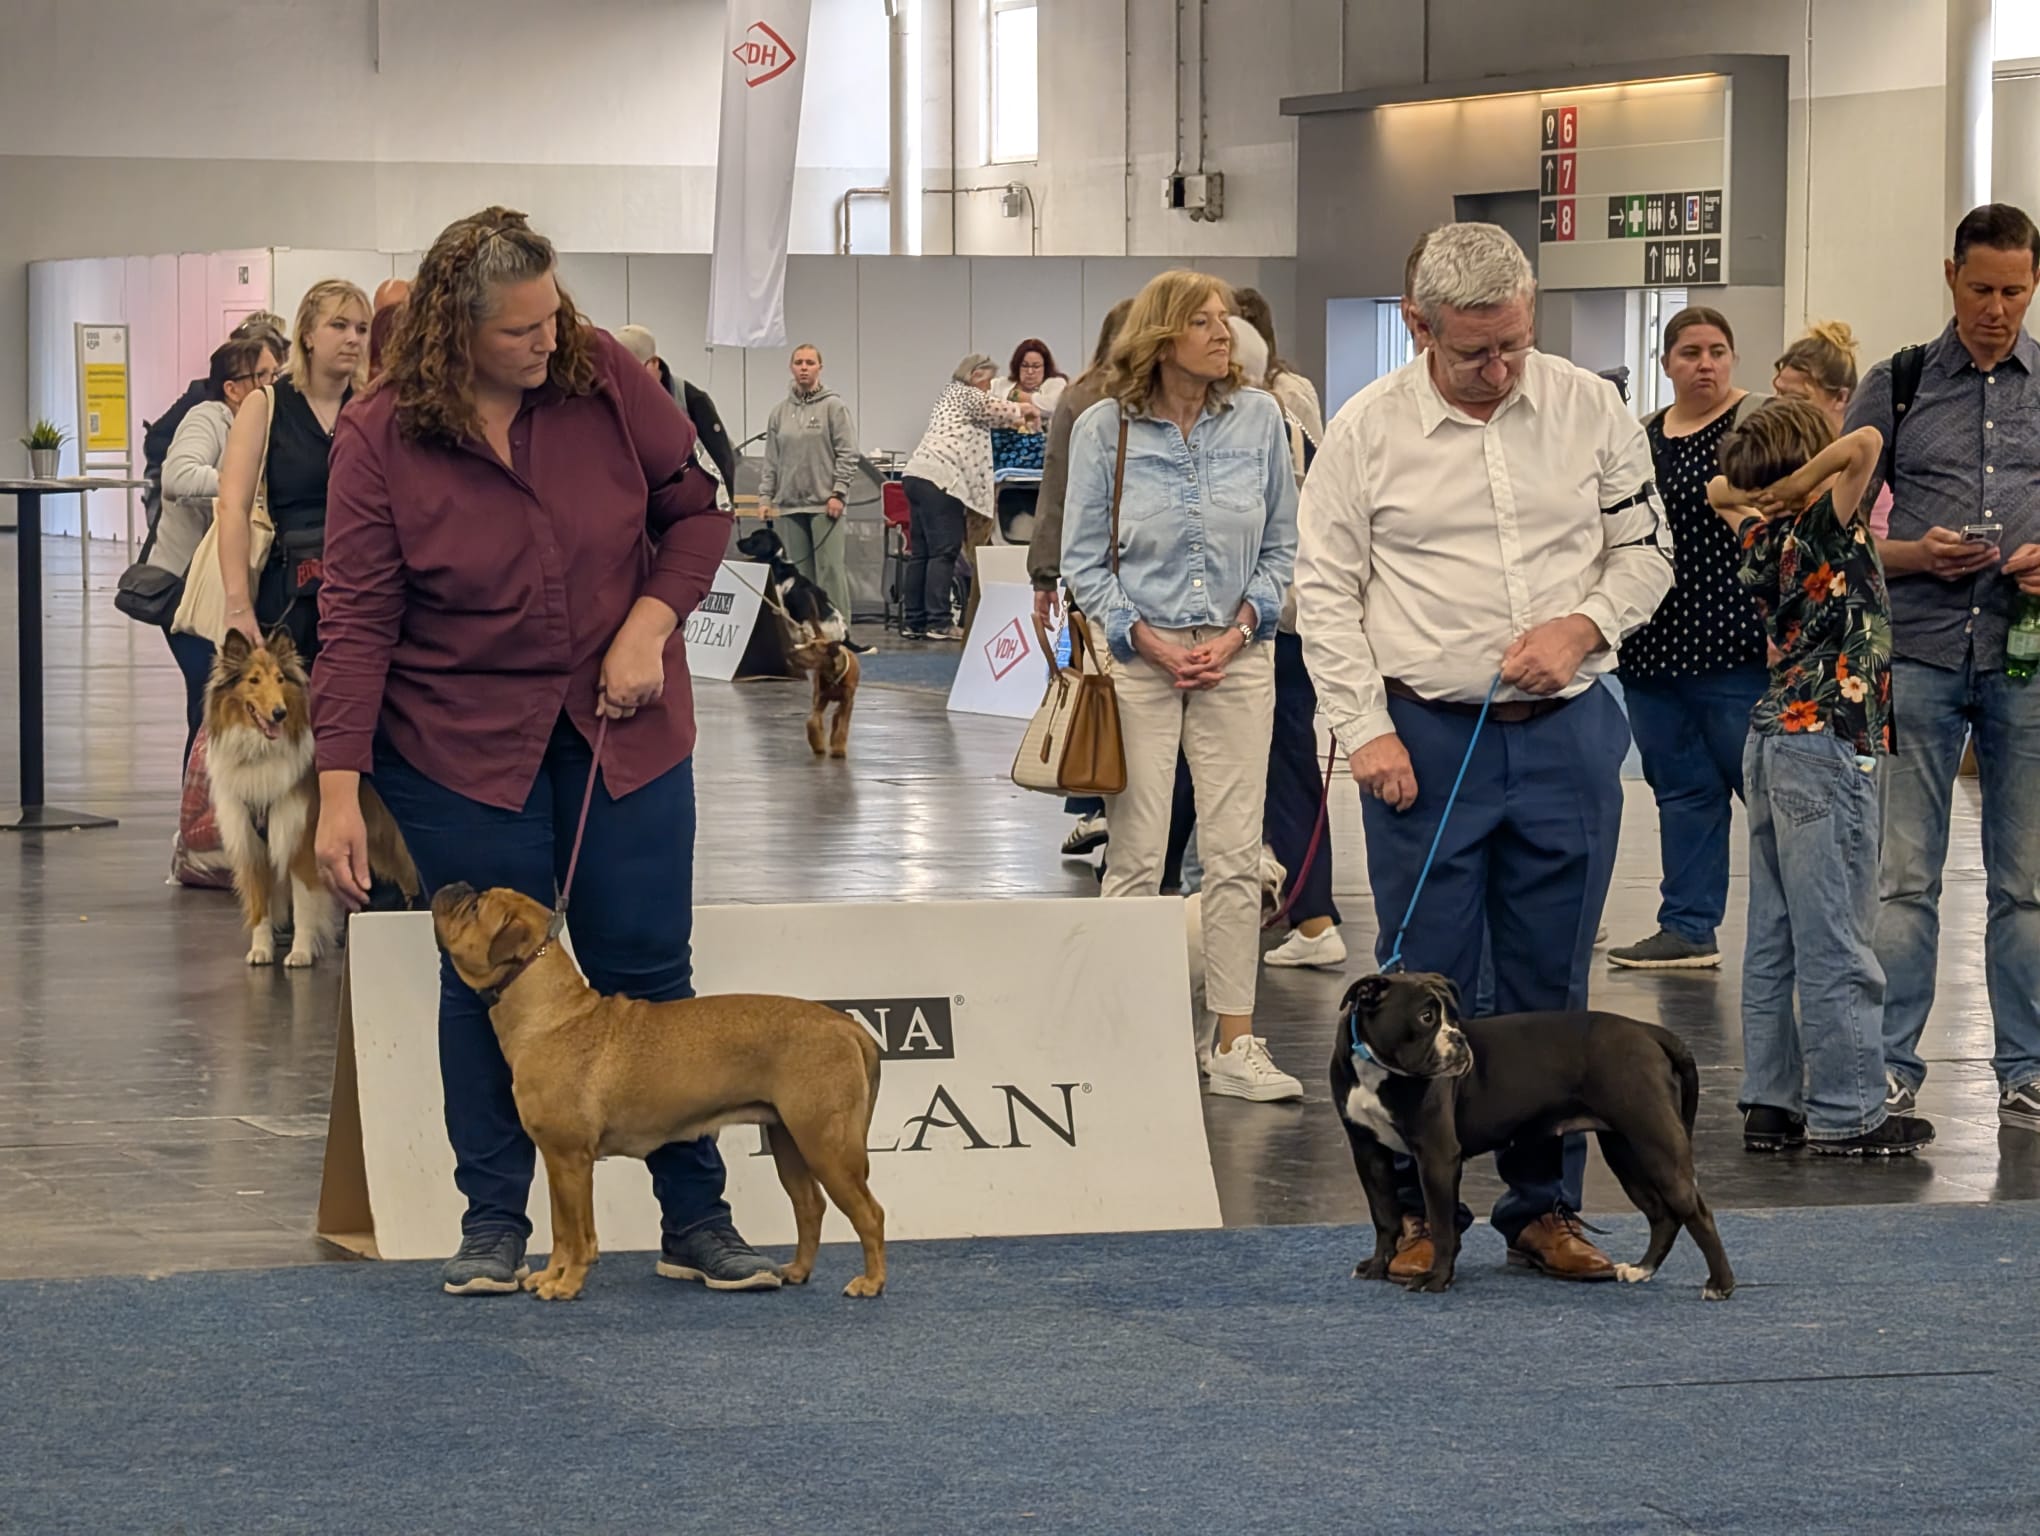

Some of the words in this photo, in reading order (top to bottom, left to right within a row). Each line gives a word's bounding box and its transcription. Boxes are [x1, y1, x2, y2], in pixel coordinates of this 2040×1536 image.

[1563, 113, 1573, 143] 6
[1563, 160, 1573, 189] 7
[1562, 205, 1572, 235] 8
[995, 637, 1019, 659] VDH
